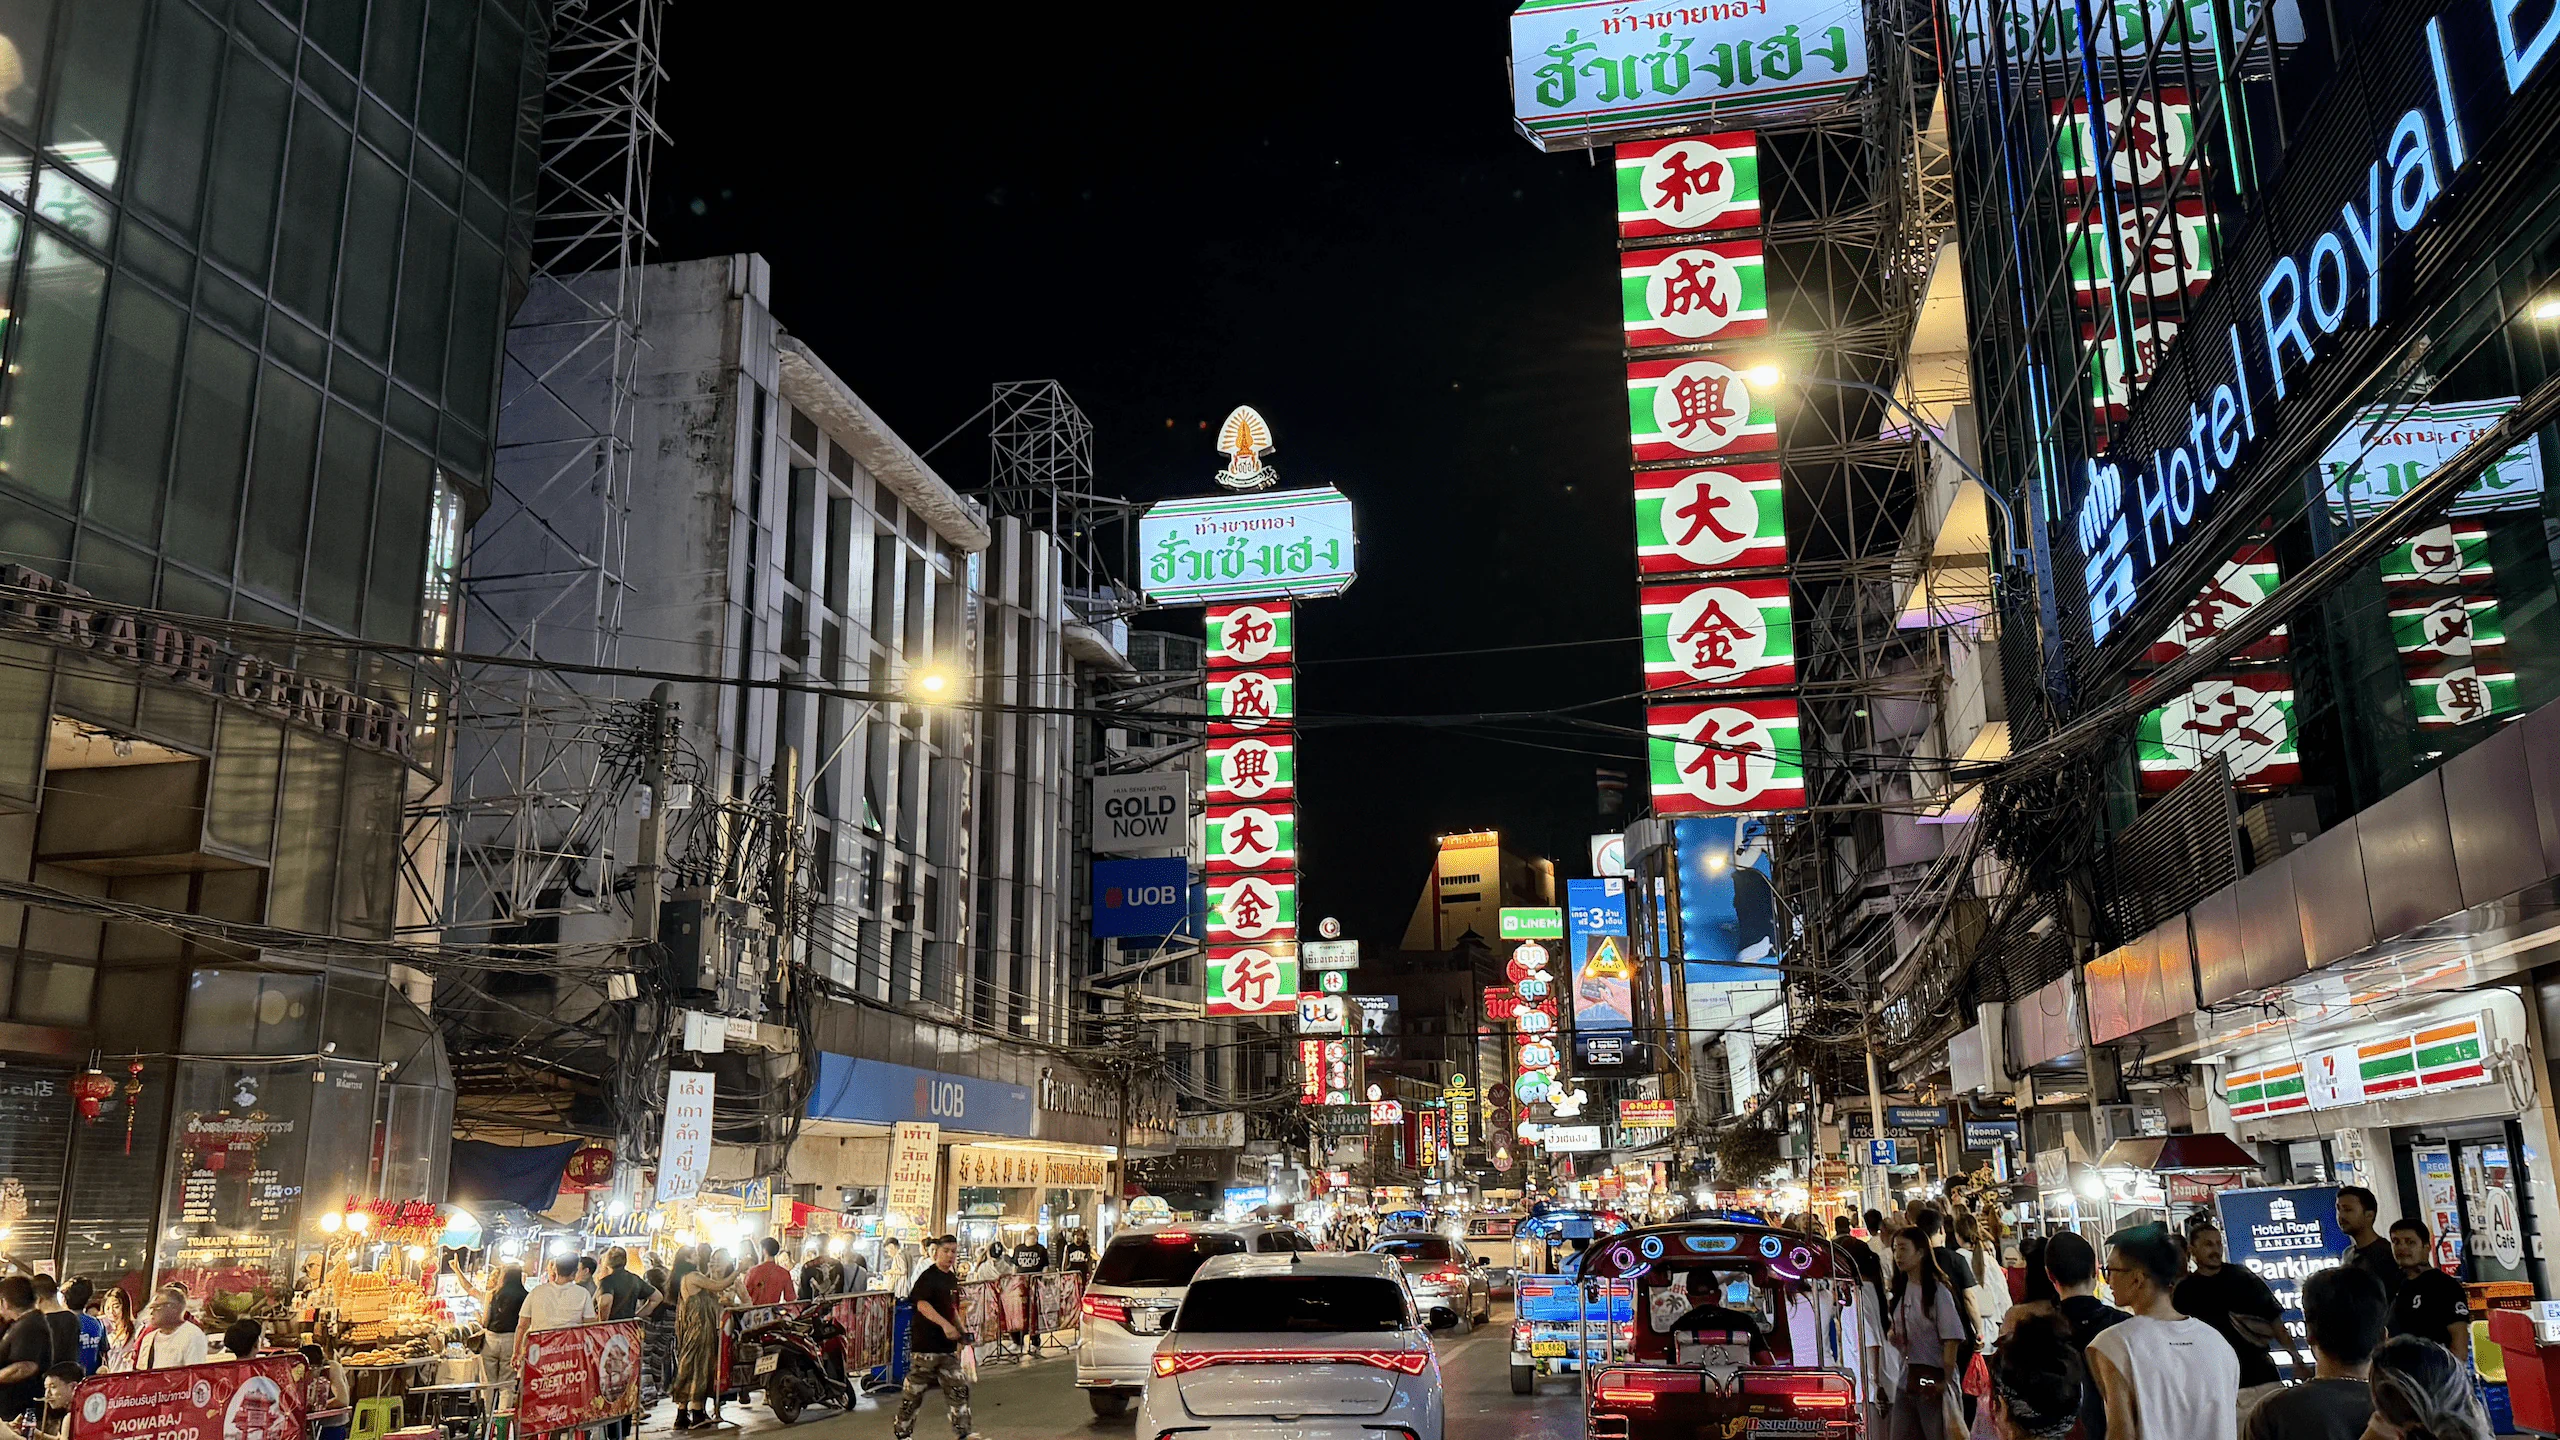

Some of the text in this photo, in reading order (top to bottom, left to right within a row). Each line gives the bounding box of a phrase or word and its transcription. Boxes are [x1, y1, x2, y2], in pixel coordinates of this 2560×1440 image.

[1600, 0, 1766, 36] ห้างขายทอง
[1532, 24, 1848, 108] ฮั่วเซ่งเฮง
[2136, 324, 2258, 567] Hotel
[2258, 16, 2465, 402] Royal
[1195, 516, 1294, 535] ห้างขายทอง
[1150, 530, 1340, 583] ฮั่วเซ่งเฮง
[232, 652, 412, 759] CENTER
[1105, 795, 1176, 818] GOLD
[1113, 817, 1168, 838] NOW
[1127, 886, 1176, 906] UOB
[1589, 907, 1605, 928] 3
[1303, 1004, 1337, 1022] ttb
[680, 1079, 704, 1096] เล้ง
[931, 1080, 964, 1118] UOB
[677, 1106, 702, 1118] เกา
[676, 1145, 694, 1171] ญี่
[668, 1173, 692, 1195] ปุ่น
[345, 1194, 399, 1220] Hlthy
[2494, 1194, 2513, 1232] All
[2251, 1219, 2321, 1237] Hotel Royal
[2254, 1236, 2323, 1248] BANGKOK
[2495, 1233, 2516, 1249] Café
[530, 1370, 588, 1390] STREET FOOD
[112, 1413, 183, 1434] YAOWARAJ
